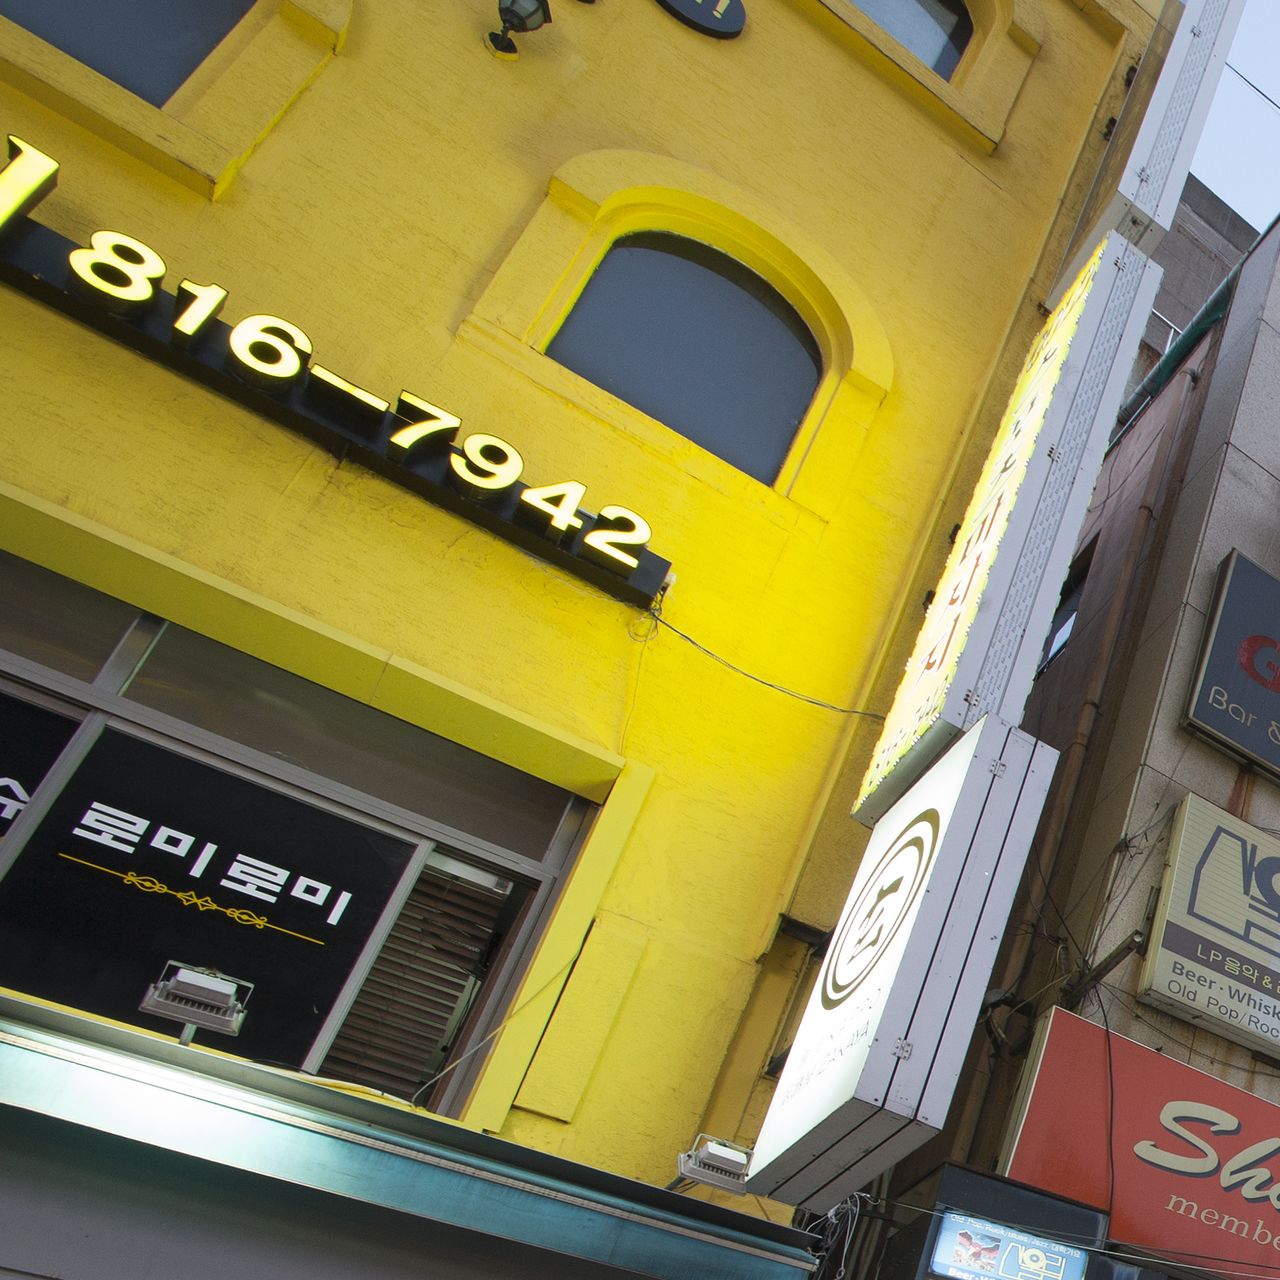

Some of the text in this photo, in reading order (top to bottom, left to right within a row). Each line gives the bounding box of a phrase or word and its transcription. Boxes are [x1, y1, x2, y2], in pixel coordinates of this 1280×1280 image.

[67, 228, 653, 568] 816-7942
[1208, 686, 1257, 728] Bar
[73, 801, 352, 925] 로미로미
[1171, 961, 1217, 991] Beer
[1197, 943, 1259, 984] LP음악
[1167, 980, 1197, 1002] Old
